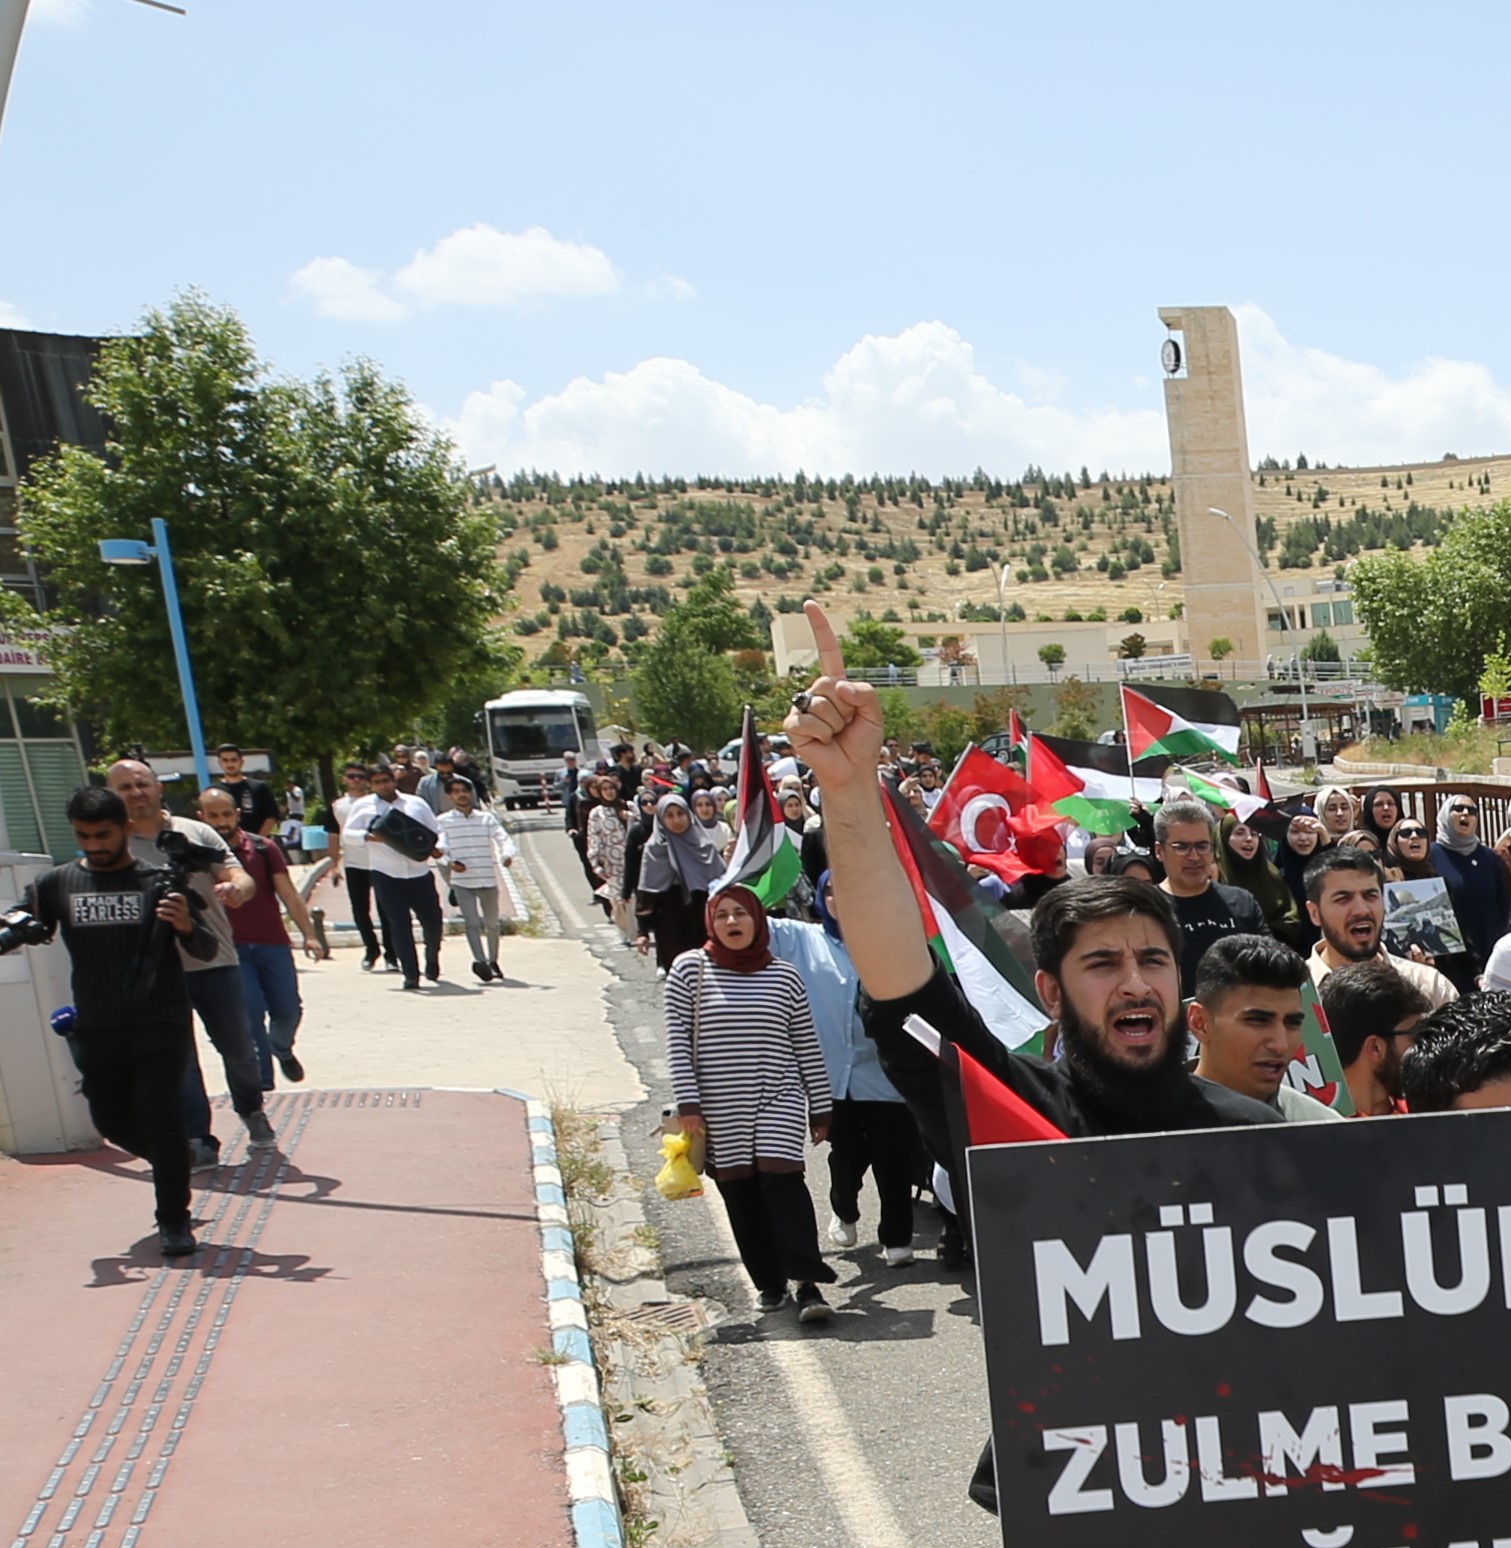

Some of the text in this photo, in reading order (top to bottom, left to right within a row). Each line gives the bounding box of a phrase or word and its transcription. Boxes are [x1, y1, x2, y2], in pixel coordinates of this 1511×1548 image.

[87, 896, 121, 907] MADE
[123, 896, 139, 905] ME
[74, 905, 140, 922] FEARLESS
[1042, 1398, 1417, 1515] ZULME
